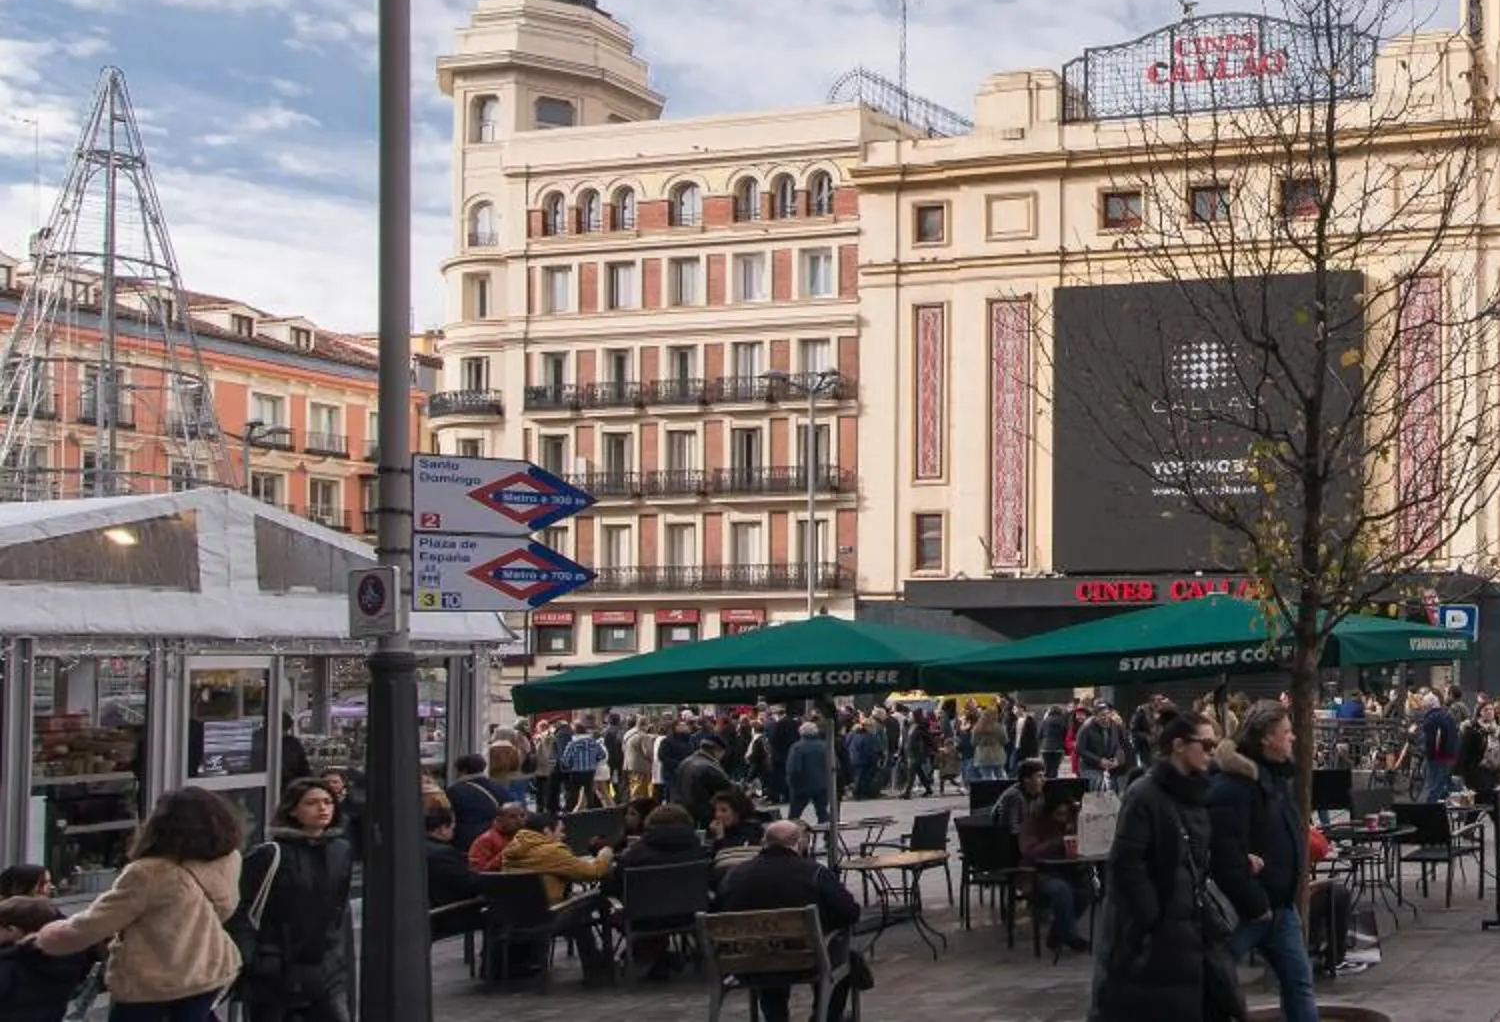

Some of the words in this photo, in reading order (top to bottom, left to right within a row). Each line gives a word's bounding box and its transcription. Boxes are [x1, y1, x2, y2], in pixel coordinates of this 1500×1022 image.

[419, 459, 460, 471] Santo
[502, 492, 537, 504] Metro
[424, 515, 437, 527] 2
[419, 538, 457, 549] Plaza
[461, 540, 477, 550] de
[502, 569, 537, 580] Metro
[1077, 580, 1153, 601] CINES
[423, 593, 435, 607] 3
[1119, 650, 1237, 671] STARBUCKS
[708, 672, 823, 690] STARBUCKS
[826, 670, 899, 684] COFFEE
